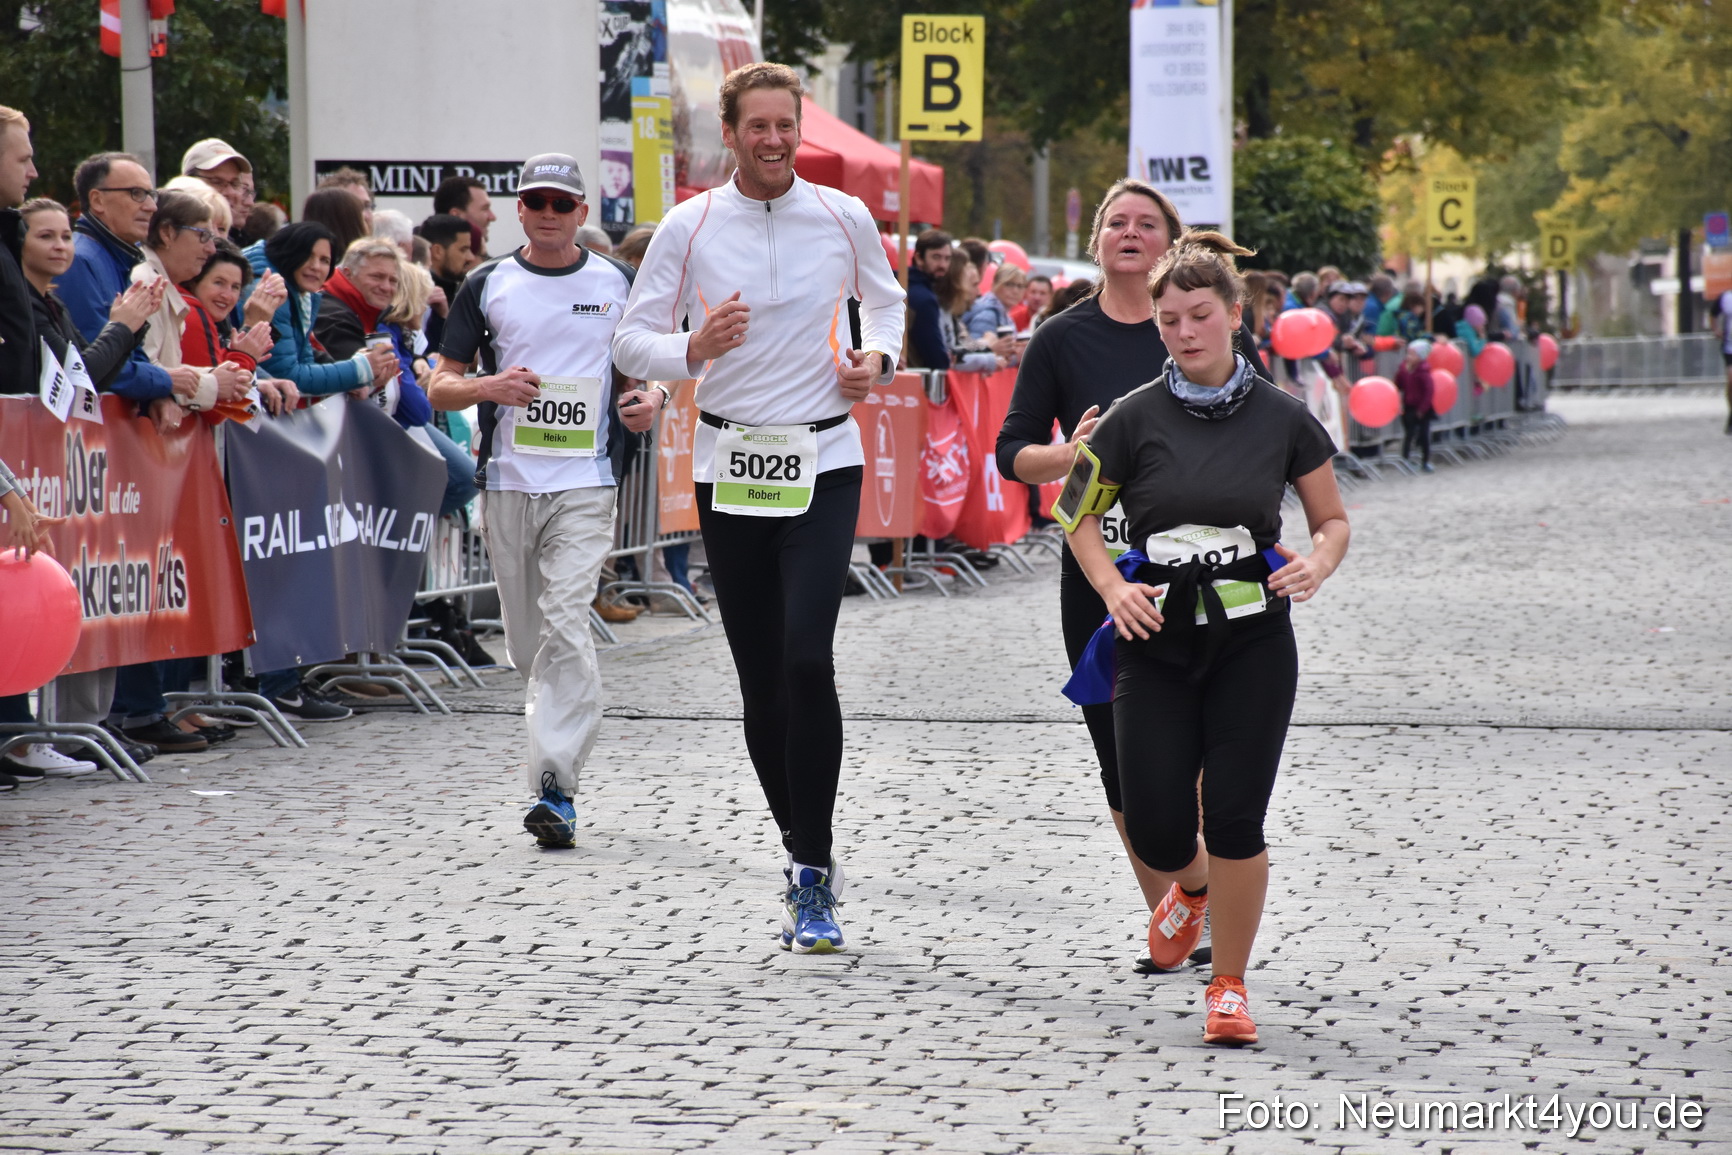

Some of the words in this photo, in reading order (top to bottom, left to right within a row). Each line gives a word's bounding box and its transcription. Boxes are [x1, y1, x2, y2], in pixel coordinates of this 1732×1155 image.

[912, 21, 975, 43] Block
[922, 54, 962, 112] B
[369, 165, 444, 193] MINI
[1439, 198, 1462, 231] C
[1550, 234, 1568, 258] D
[548, 382, 578, 392] BOCK
[526, 398, 587, 426] 5096
[543, 432, 568, 443] Heiko
[752, 433, 788, 443] BOCK
[729, 451, 802, 482] 5028
[122, 483, 141, 514] die
[747, 488, 781, 501] Robert
